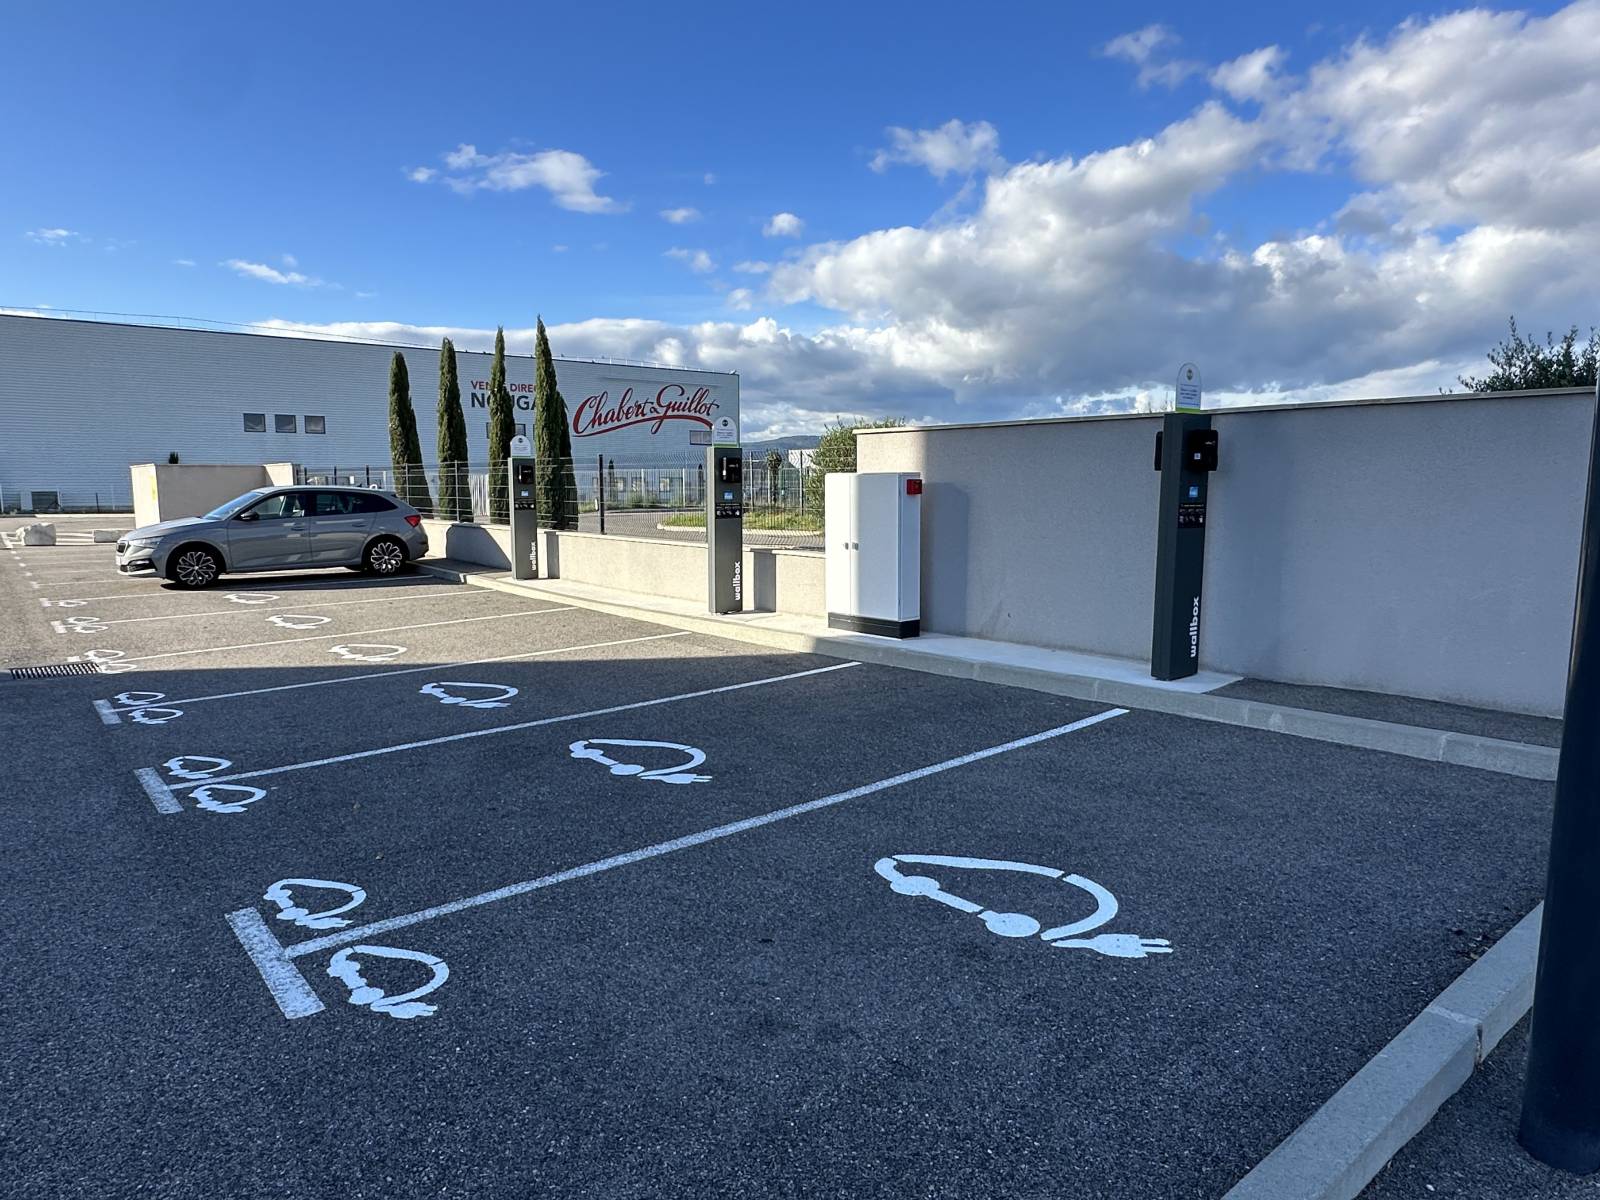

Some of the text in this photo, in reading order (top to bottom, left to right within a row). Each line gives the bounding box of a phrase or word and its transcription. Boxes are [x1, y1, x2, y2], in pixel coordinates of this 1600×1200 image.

[572, 387, 654, 434] Chabert
[650, 384, 720, 435] Guillot
[529, 541, 537, 571] wallbox
[732, 561, 741, 601] wallbox
[1189, 596, 1200, 658] wallbox
